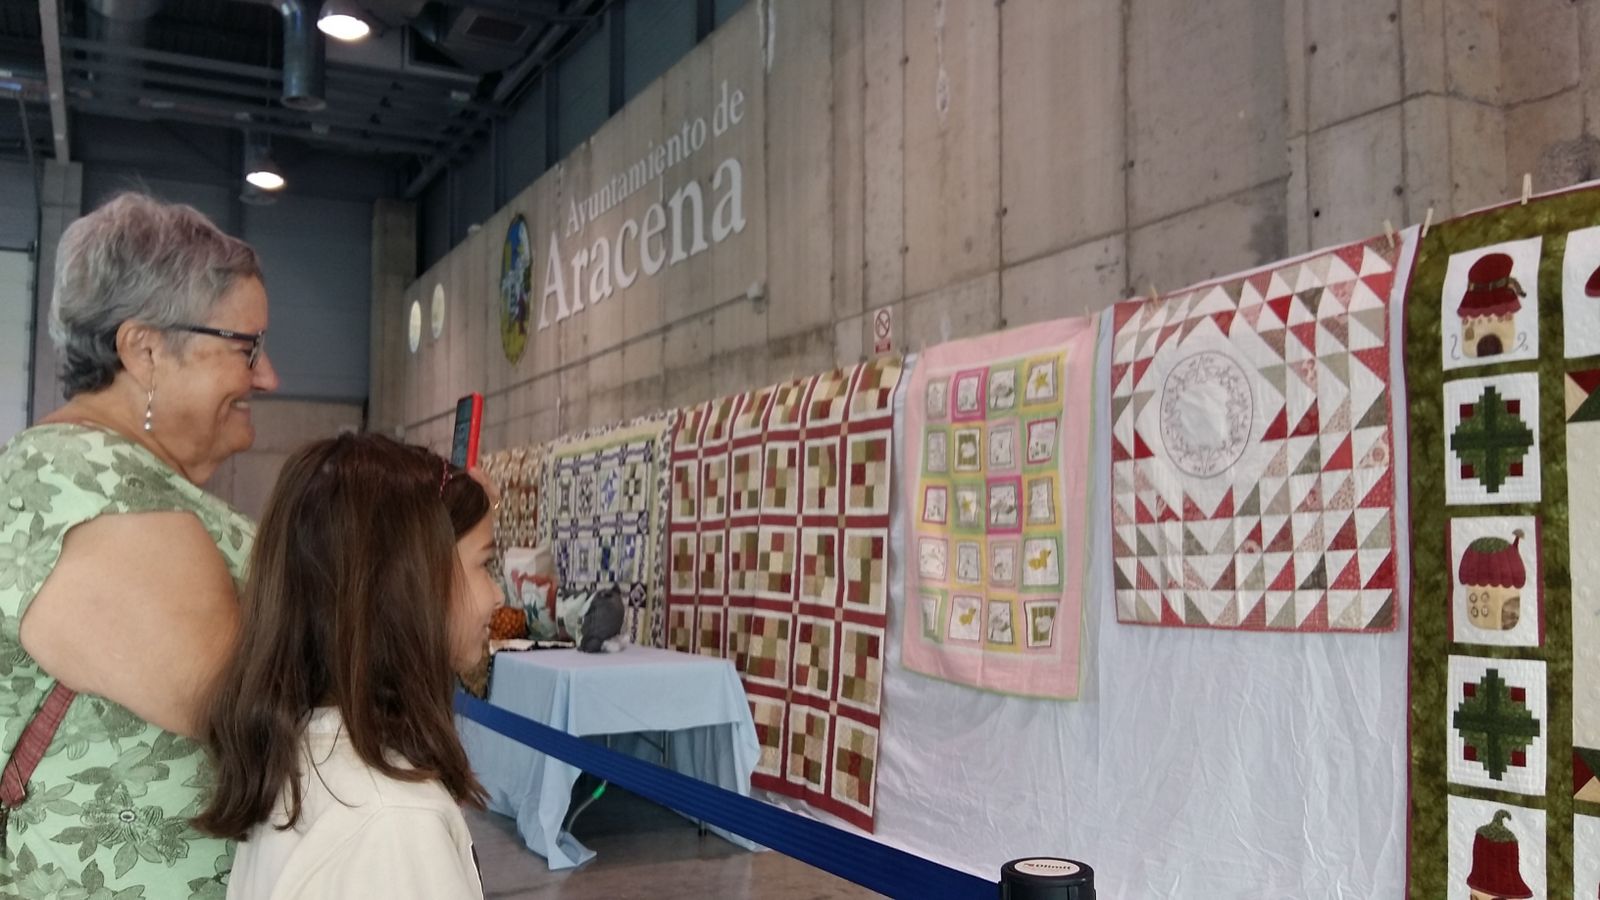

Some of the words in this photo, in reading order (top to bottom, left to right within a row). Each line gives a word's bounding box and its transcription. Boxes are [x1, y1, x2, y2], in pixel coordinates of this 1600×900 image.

[566, 117, 706, 239] Ayuntamiento
[713, 79, 744, 138] de
[538, 157, 746, 331] Aracena
